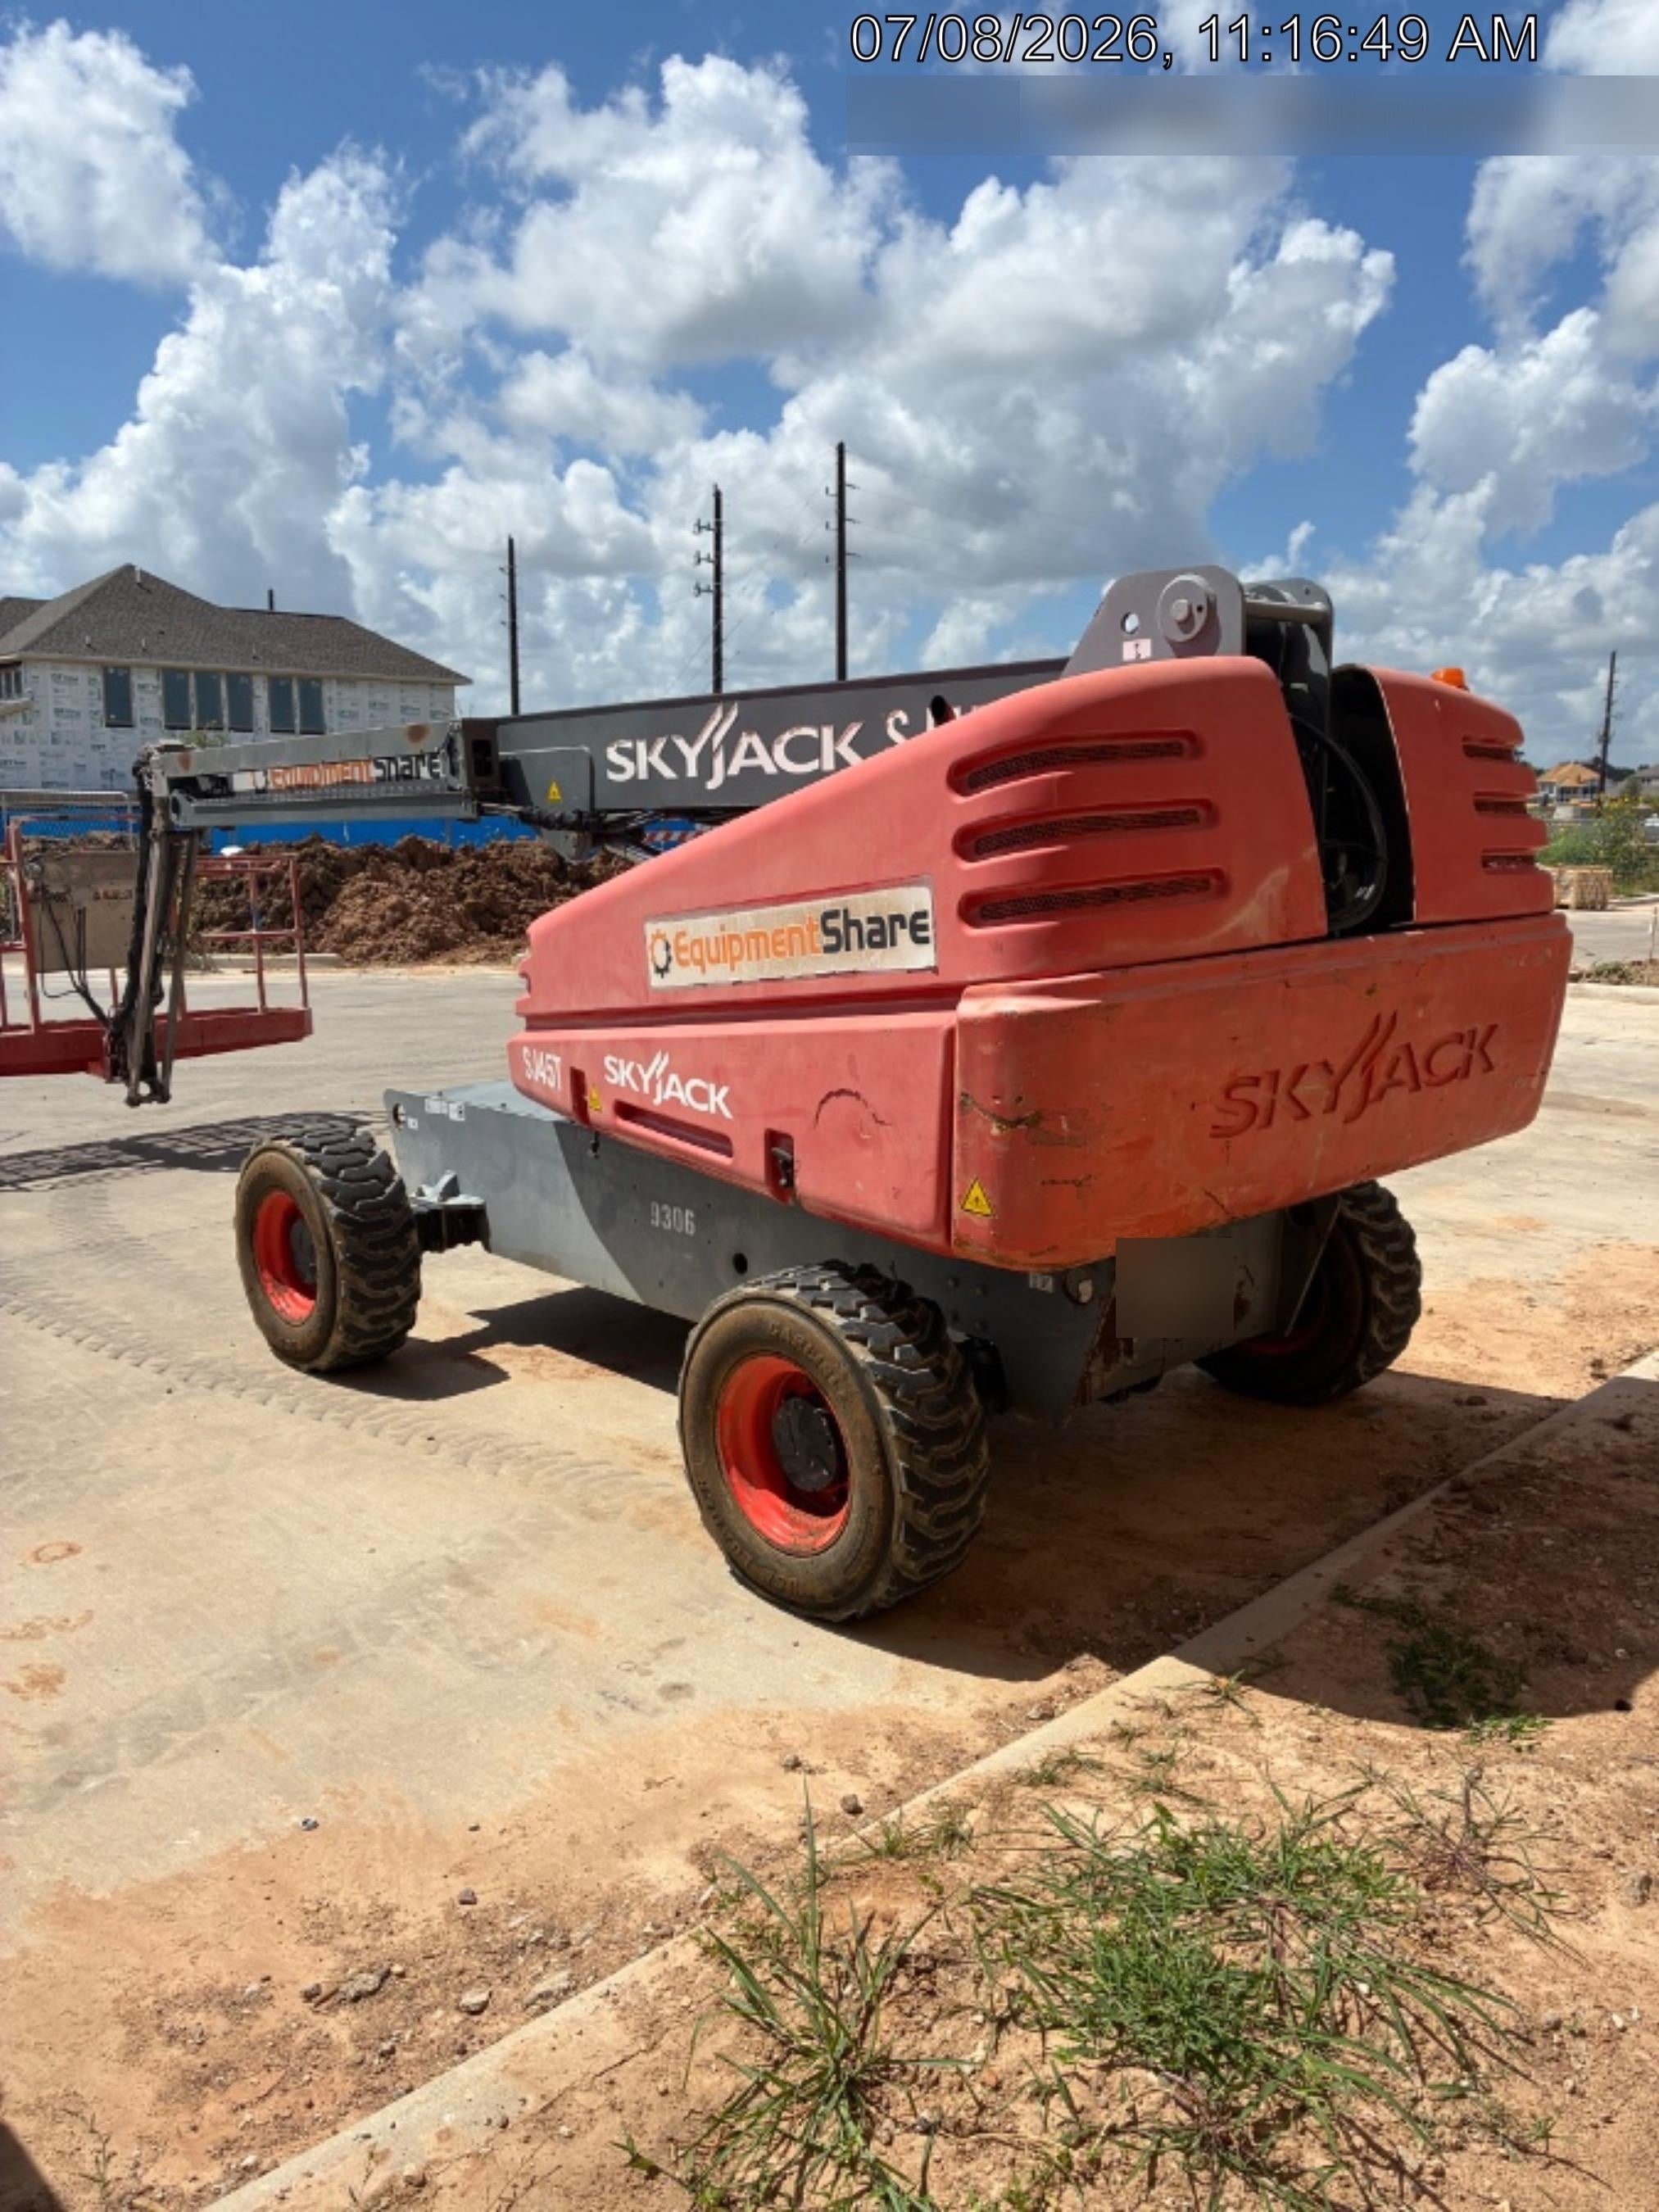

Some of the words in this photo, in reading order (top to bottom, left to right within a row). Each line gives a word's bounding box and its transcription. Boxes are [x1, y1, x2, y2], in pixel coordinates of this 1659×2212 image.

[606, 700, 865, 791] SKYJACK
[673, 908, 931, 974] EquipmentShare
[522, 1045, 562, 1091] SJ45T
[603, 1049, 733, 1120] SKYJACK
[1208, 1009, 1498, 1139] SKYJACK
[650, 1200, 696, 1237] 9306
